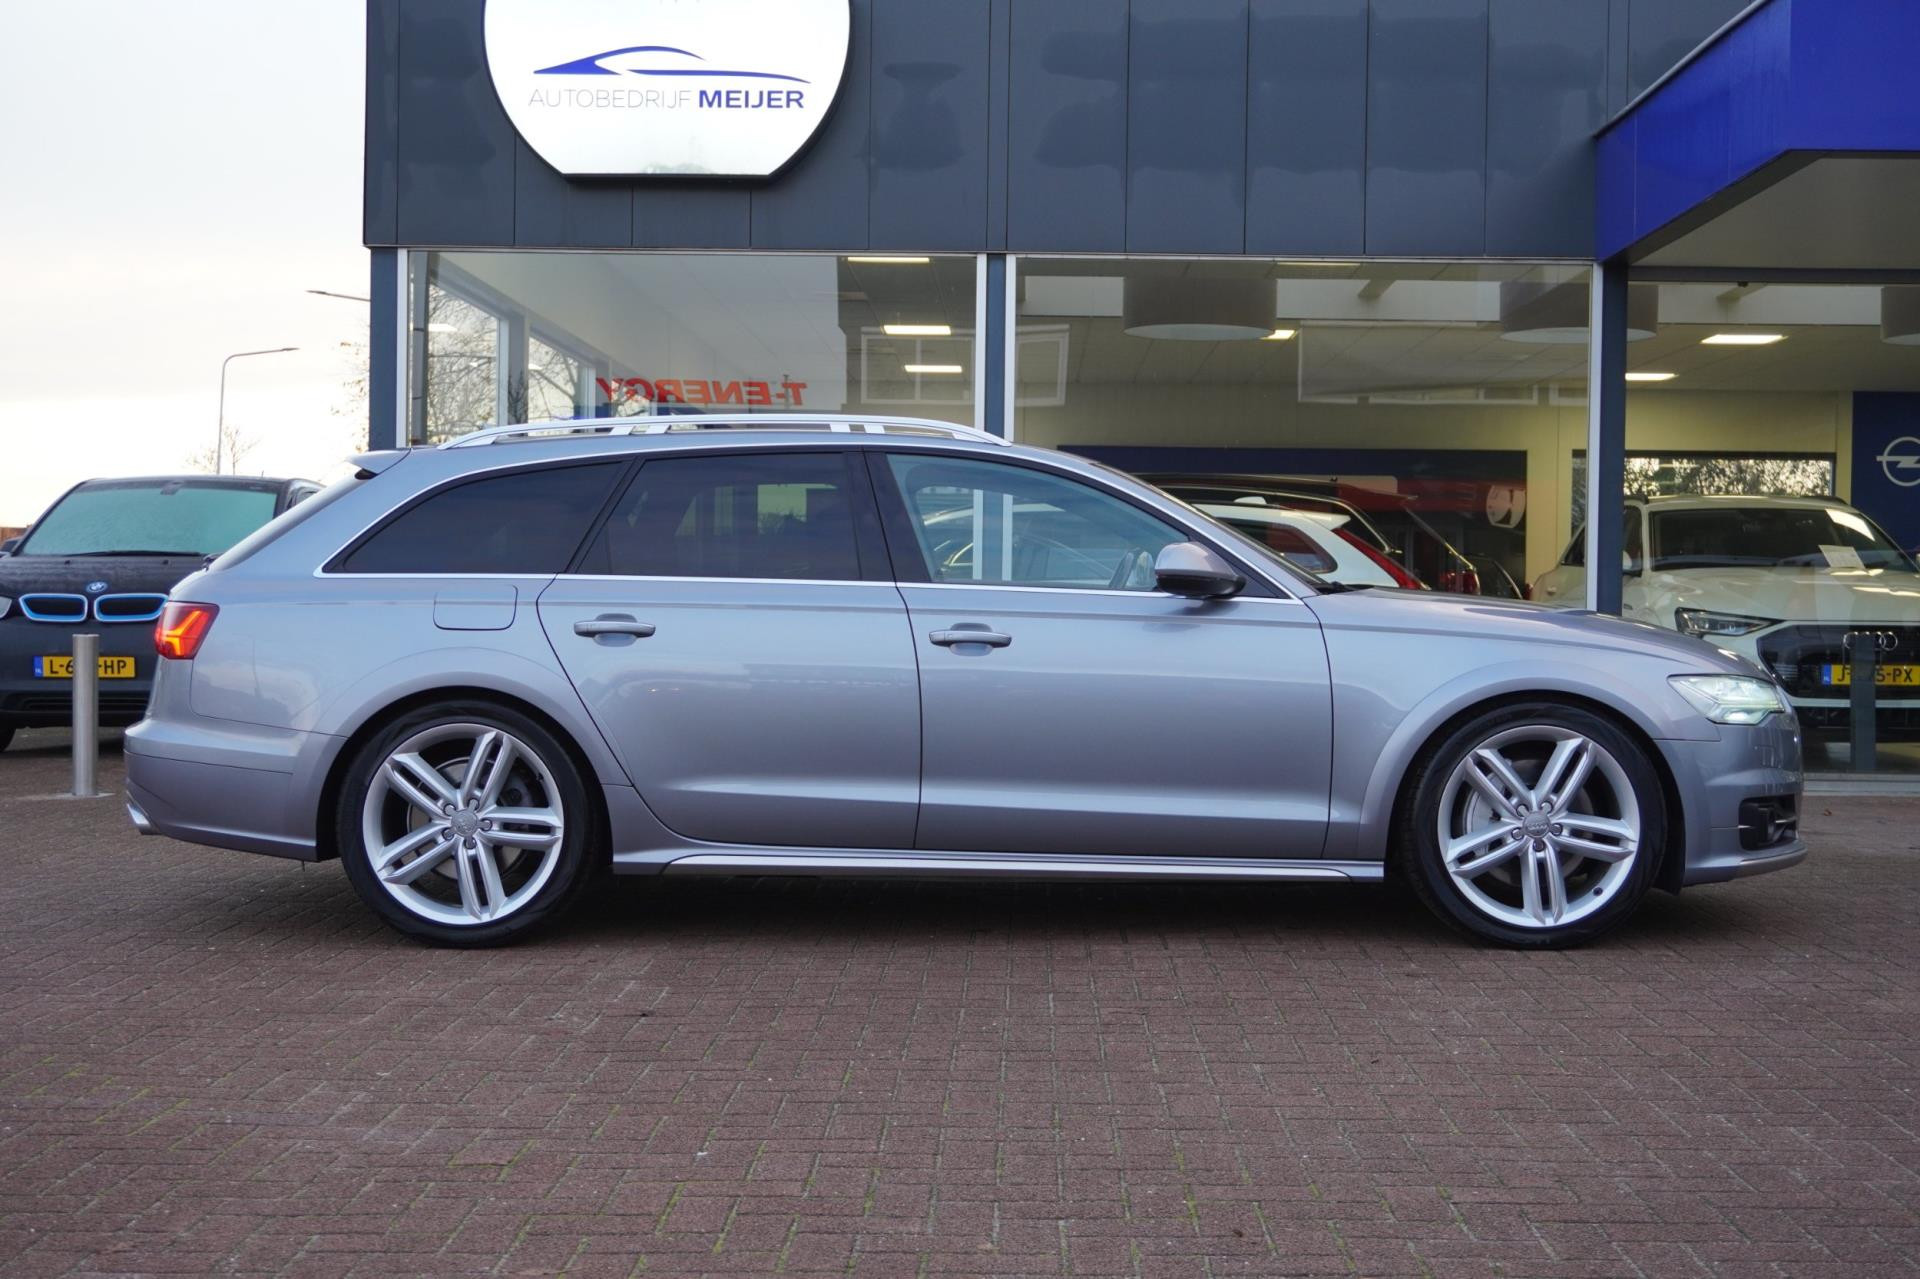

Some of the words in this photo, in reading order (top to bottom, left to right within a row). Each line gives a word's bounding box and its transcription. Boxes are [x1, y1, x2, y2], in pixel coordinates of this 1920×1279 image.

[528, 88, 692, 109] AUTOBEDRIJF
[698, 89, 805, 109] MEIJER
[49, 659, 127, 675] L-6-HP
